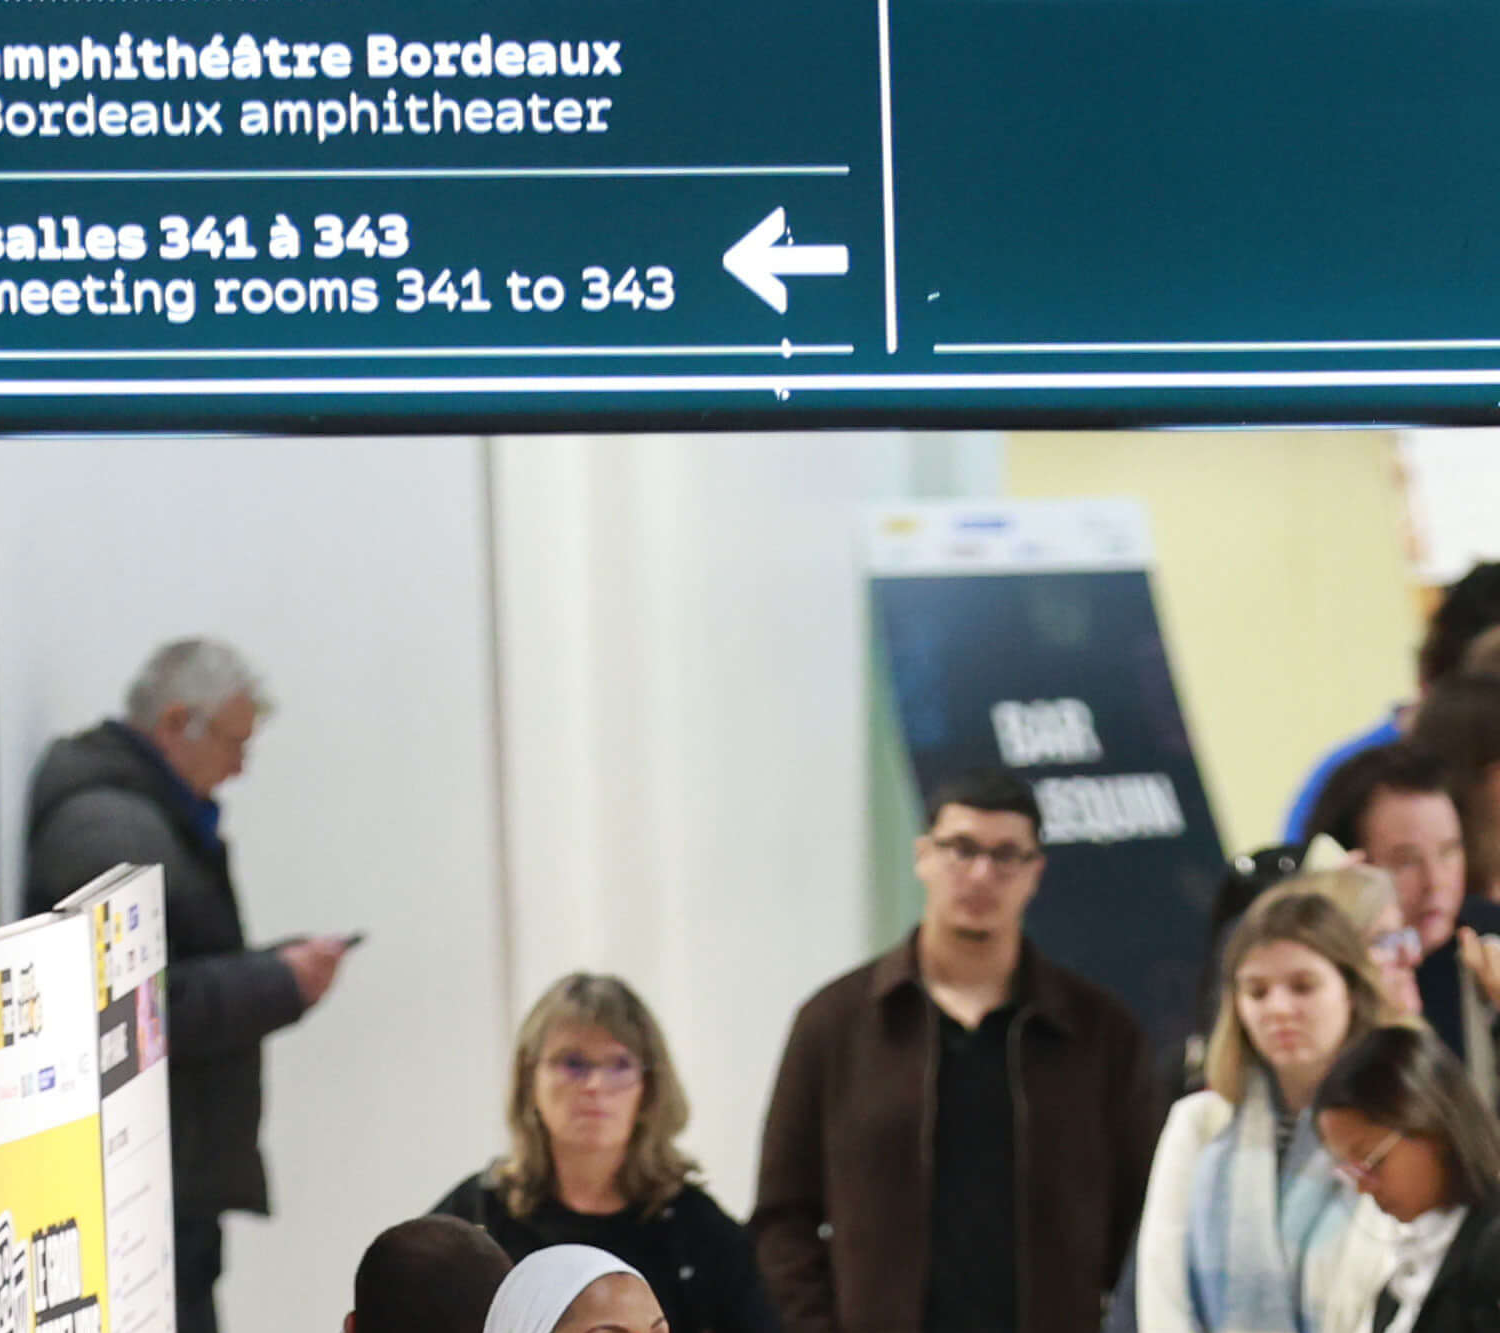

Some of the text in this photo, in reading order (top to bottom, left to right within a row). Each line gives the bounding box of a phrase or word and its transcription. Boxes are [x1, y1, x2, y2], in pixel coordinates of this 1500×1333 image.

[367, 33, 622, 78] Bordeaux
[240, 87, 612, 144] amphitheater
[158, 214, 258, 260] 341
[268, 212, 301, 260] à
[313, 213, 410, 259] 343
[213, 277, 380, 315] rooms
[395, 267, 492, 313] 341
[505, 270, 566, 312] to
[581, 265, 676, 312] 343
